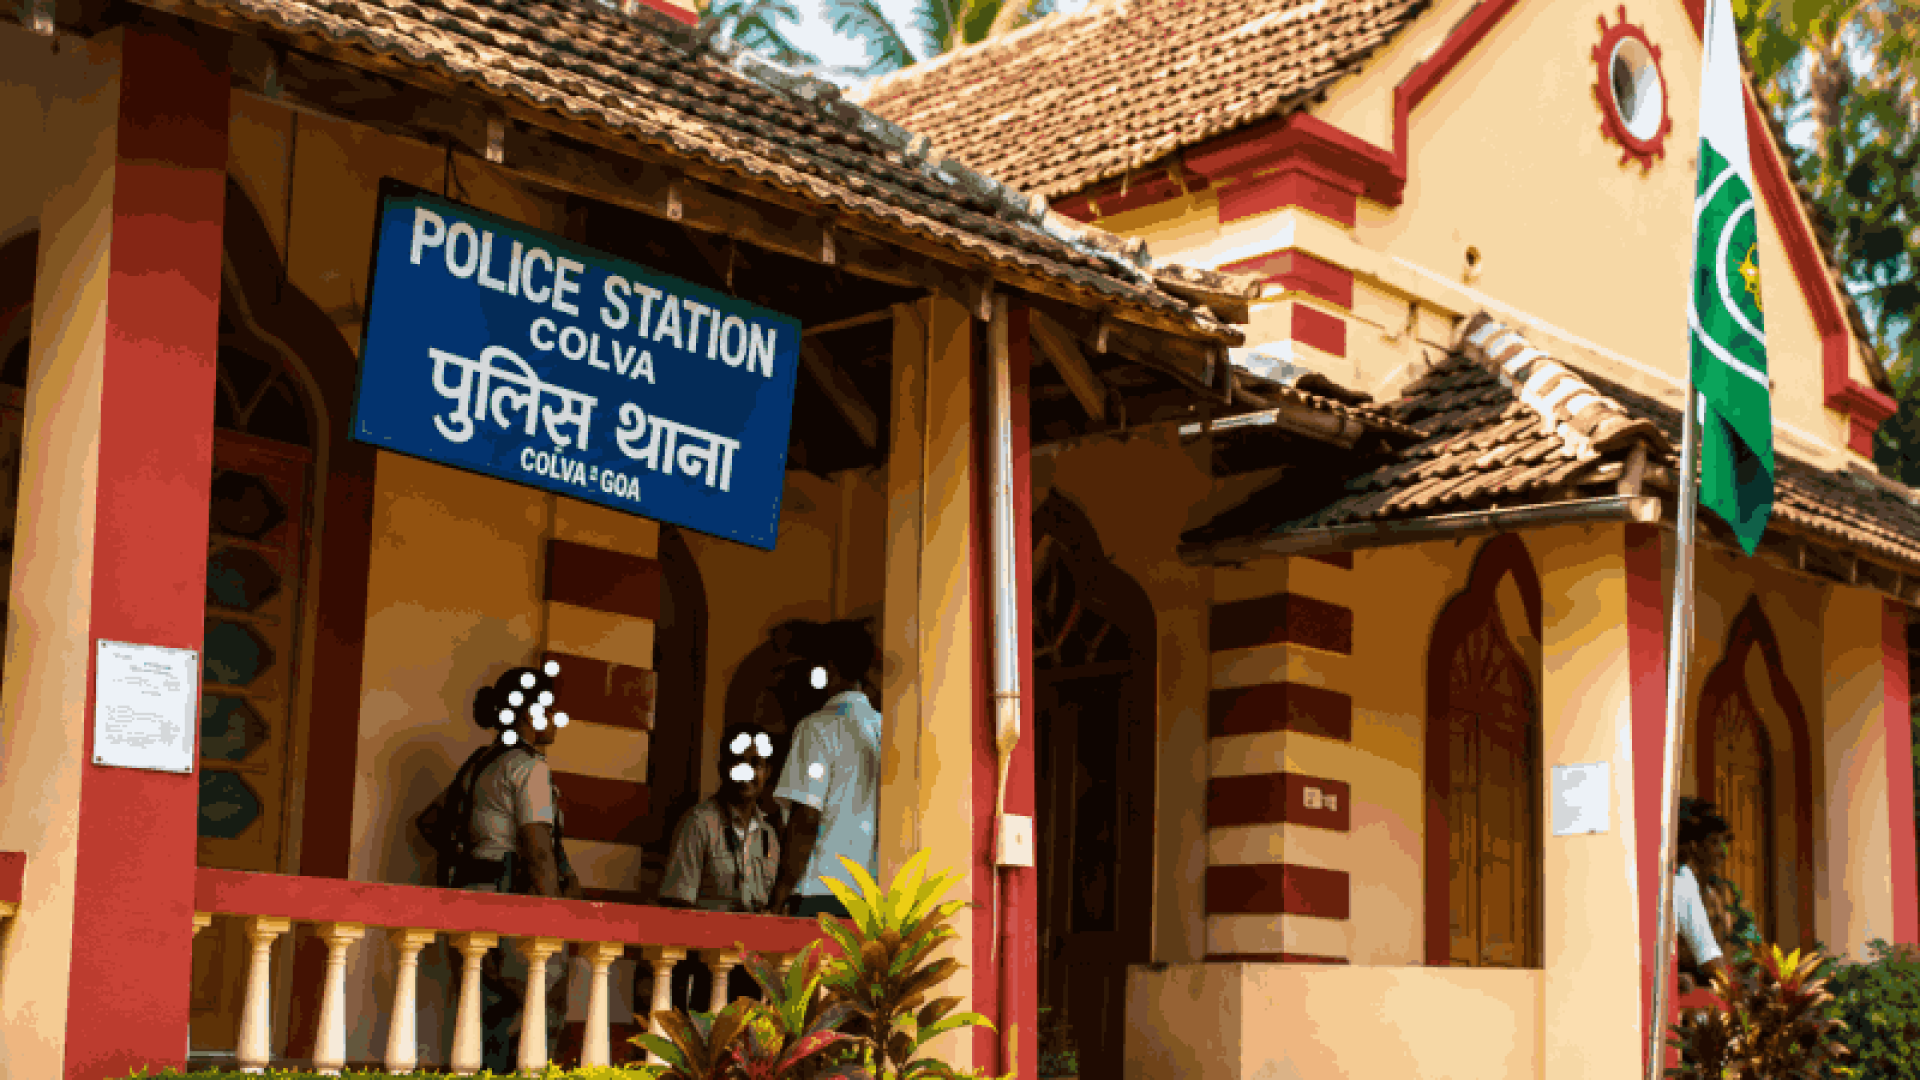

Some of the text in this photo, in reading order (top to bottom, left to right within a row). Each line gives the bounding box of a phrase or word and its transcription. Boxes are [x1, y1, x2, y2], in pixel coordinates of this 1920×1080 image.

[409, 206, 777, 378] POLICE STATION
[529, 316, 656, 385] COLVA
[428, 345, 741, 493] पुलिस थाना
